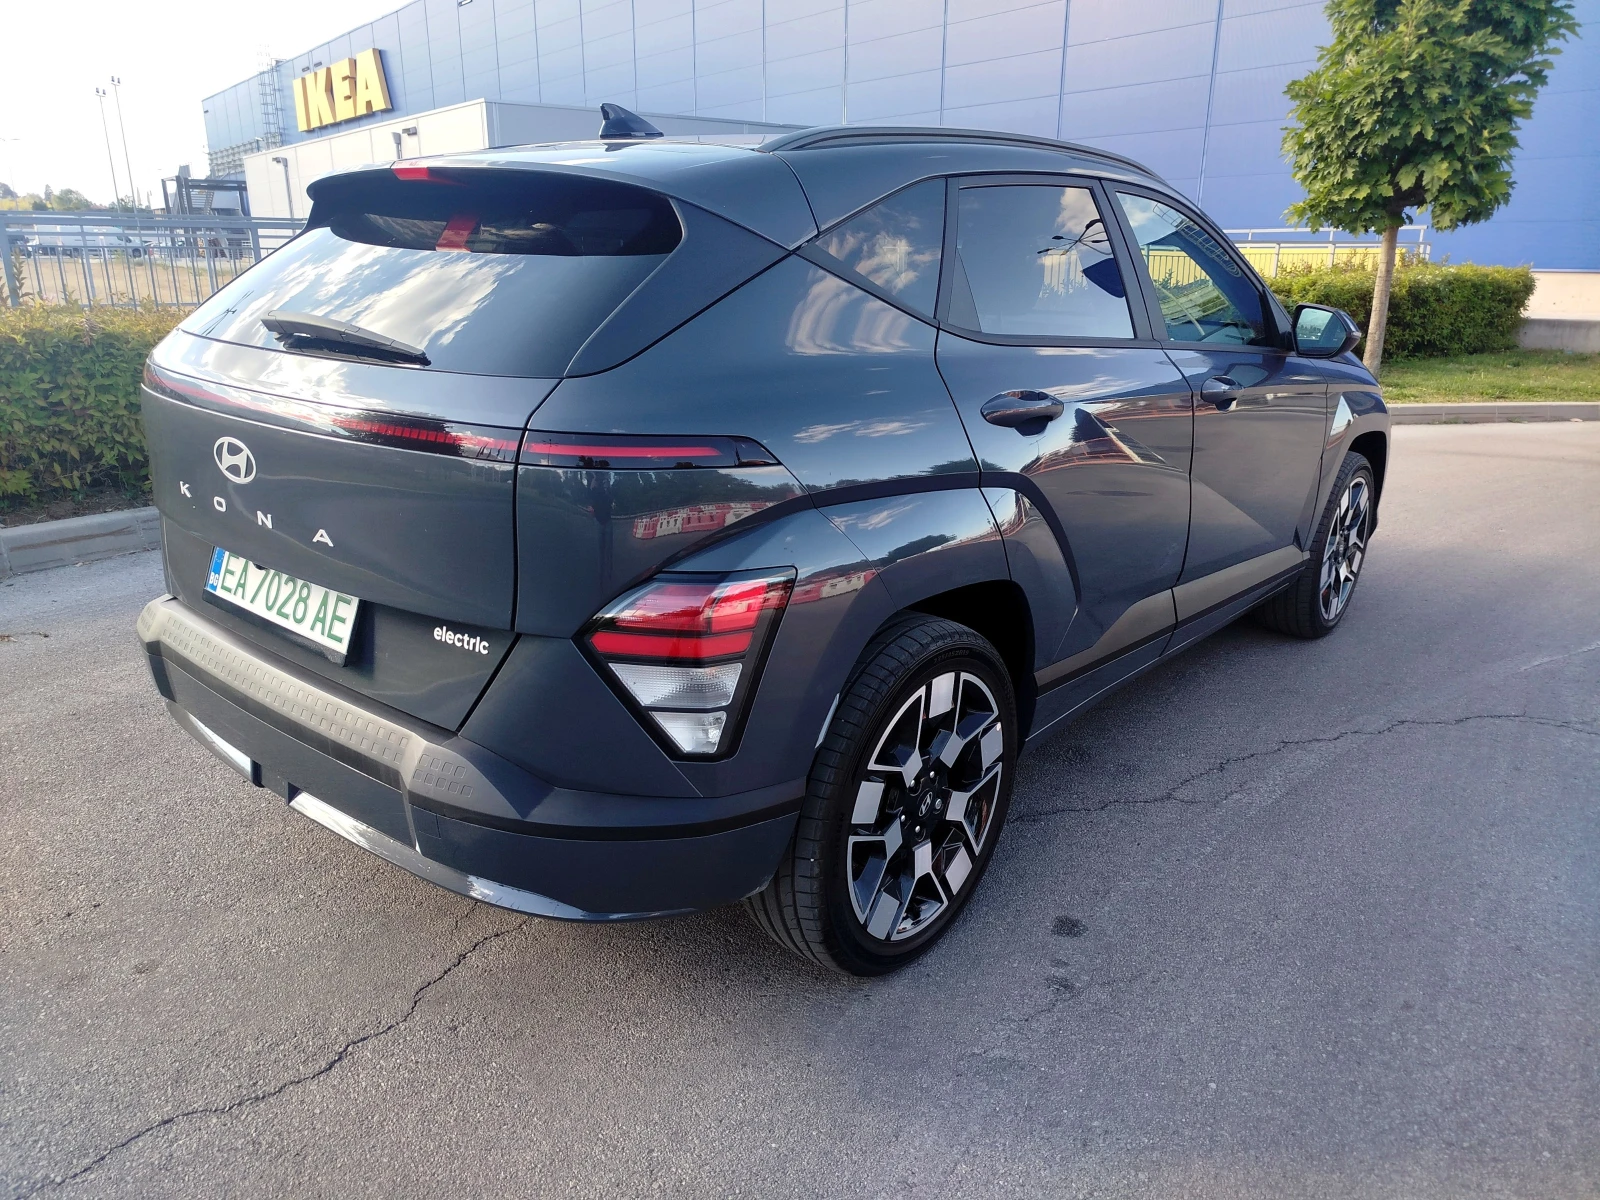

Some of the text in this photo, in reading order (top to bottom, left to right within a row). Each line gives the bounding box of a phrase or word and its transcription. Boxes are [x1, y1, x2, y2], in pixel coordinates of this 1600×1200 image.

[293, 48, 392, 132] IKEA
[179, 481, 334, 547] KONA
[209, 573, 220, 586] BG
[220, 553, 353, 643] EA 7028 AE
[433, 625, 489, 655] electric
